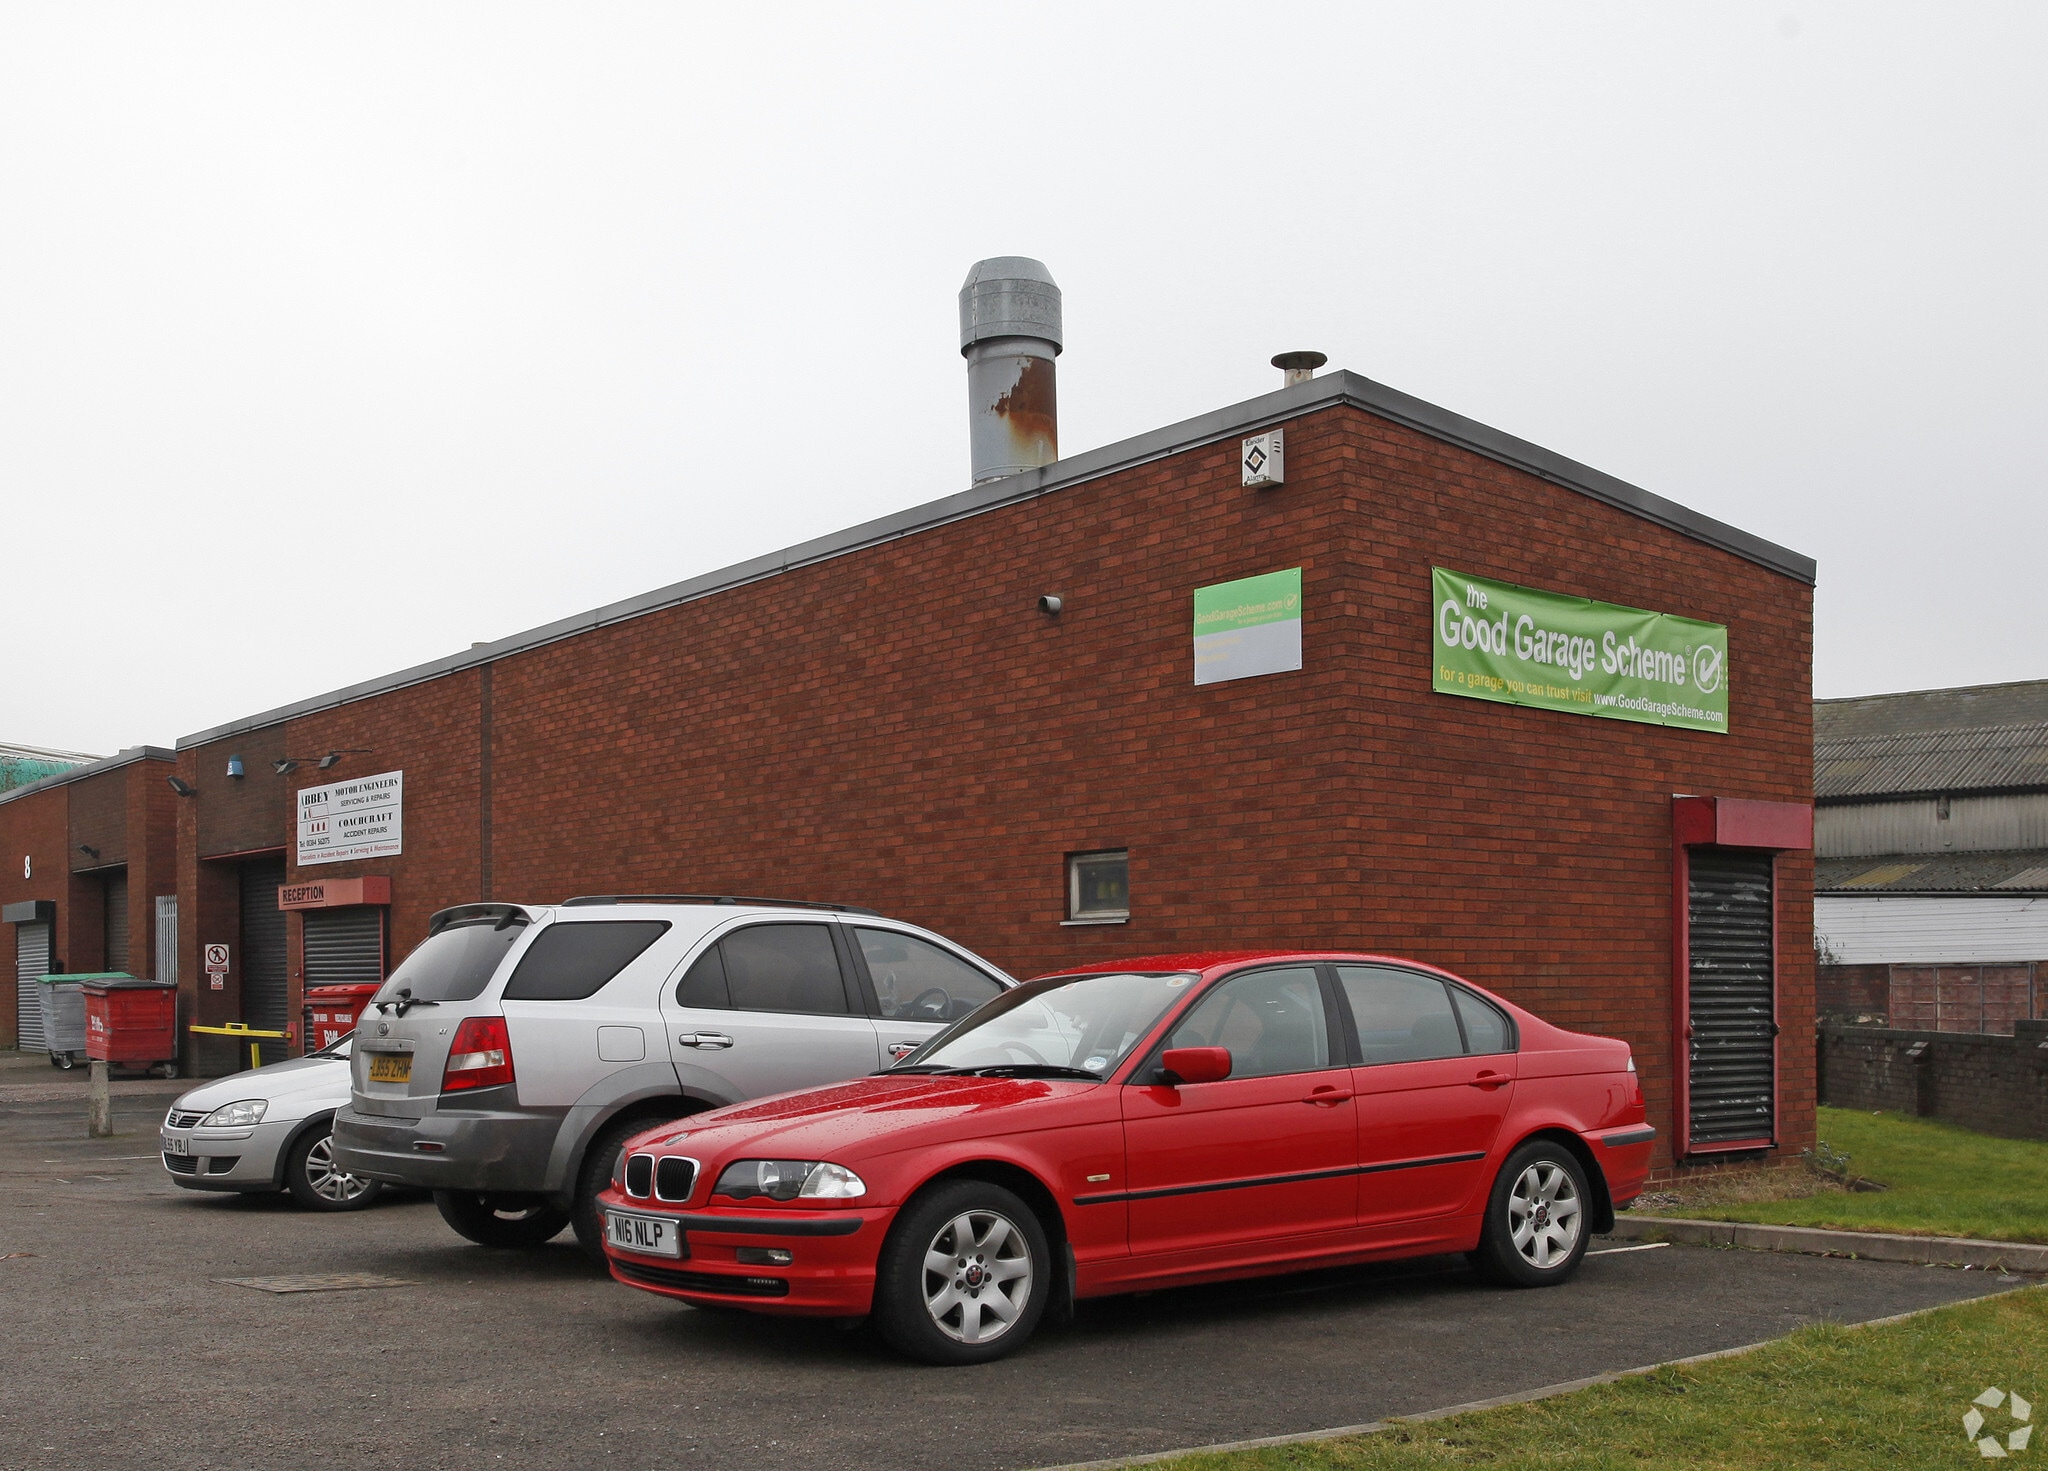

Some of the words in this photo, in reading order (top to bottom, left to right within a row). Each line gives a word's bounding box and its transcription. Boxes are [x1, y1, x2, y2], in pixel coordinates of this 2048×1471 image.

[1466, 584, 1488, 610] the
[1439, 599, 1508, 656] Good
[1514, 614, 1595, 681] Garage
[1601, 630, 1685, 686] Scheme
[1439, 665, 1455, 682] for
[1458, 671, 1465, 683] a
[1467, 673, 1504, 692] garage
[1506, 679, 1524, 694] you
[1526, 683, 1544, 696] can
[1546, 683, 1570, 699] trust
[1571, 687, 1592, 704] visit
[1593, 693, 1723, 722] www.GoodGarageScheme.com
[335, 784, 358, 797] MOTOR
[359, 778, 399, 793] ENGINEERS
[300, 790, 330, 807] ABBEY
[340, 796, 365, 807] SERVICING
[370, 792, 391, 802] REPAIRS
[338, 812, 393, 828] COACHCRAFT
[343, 828, 367, 839] ACCIDENT
[367, 825, 388, 836] REPAIRS
[24, 855, 31, 879] 8
[282, 885, 324, 902] RECEPTION
[615, 1217, 633, 1243] N16
[635, 1220, 663, 1248] NLP
